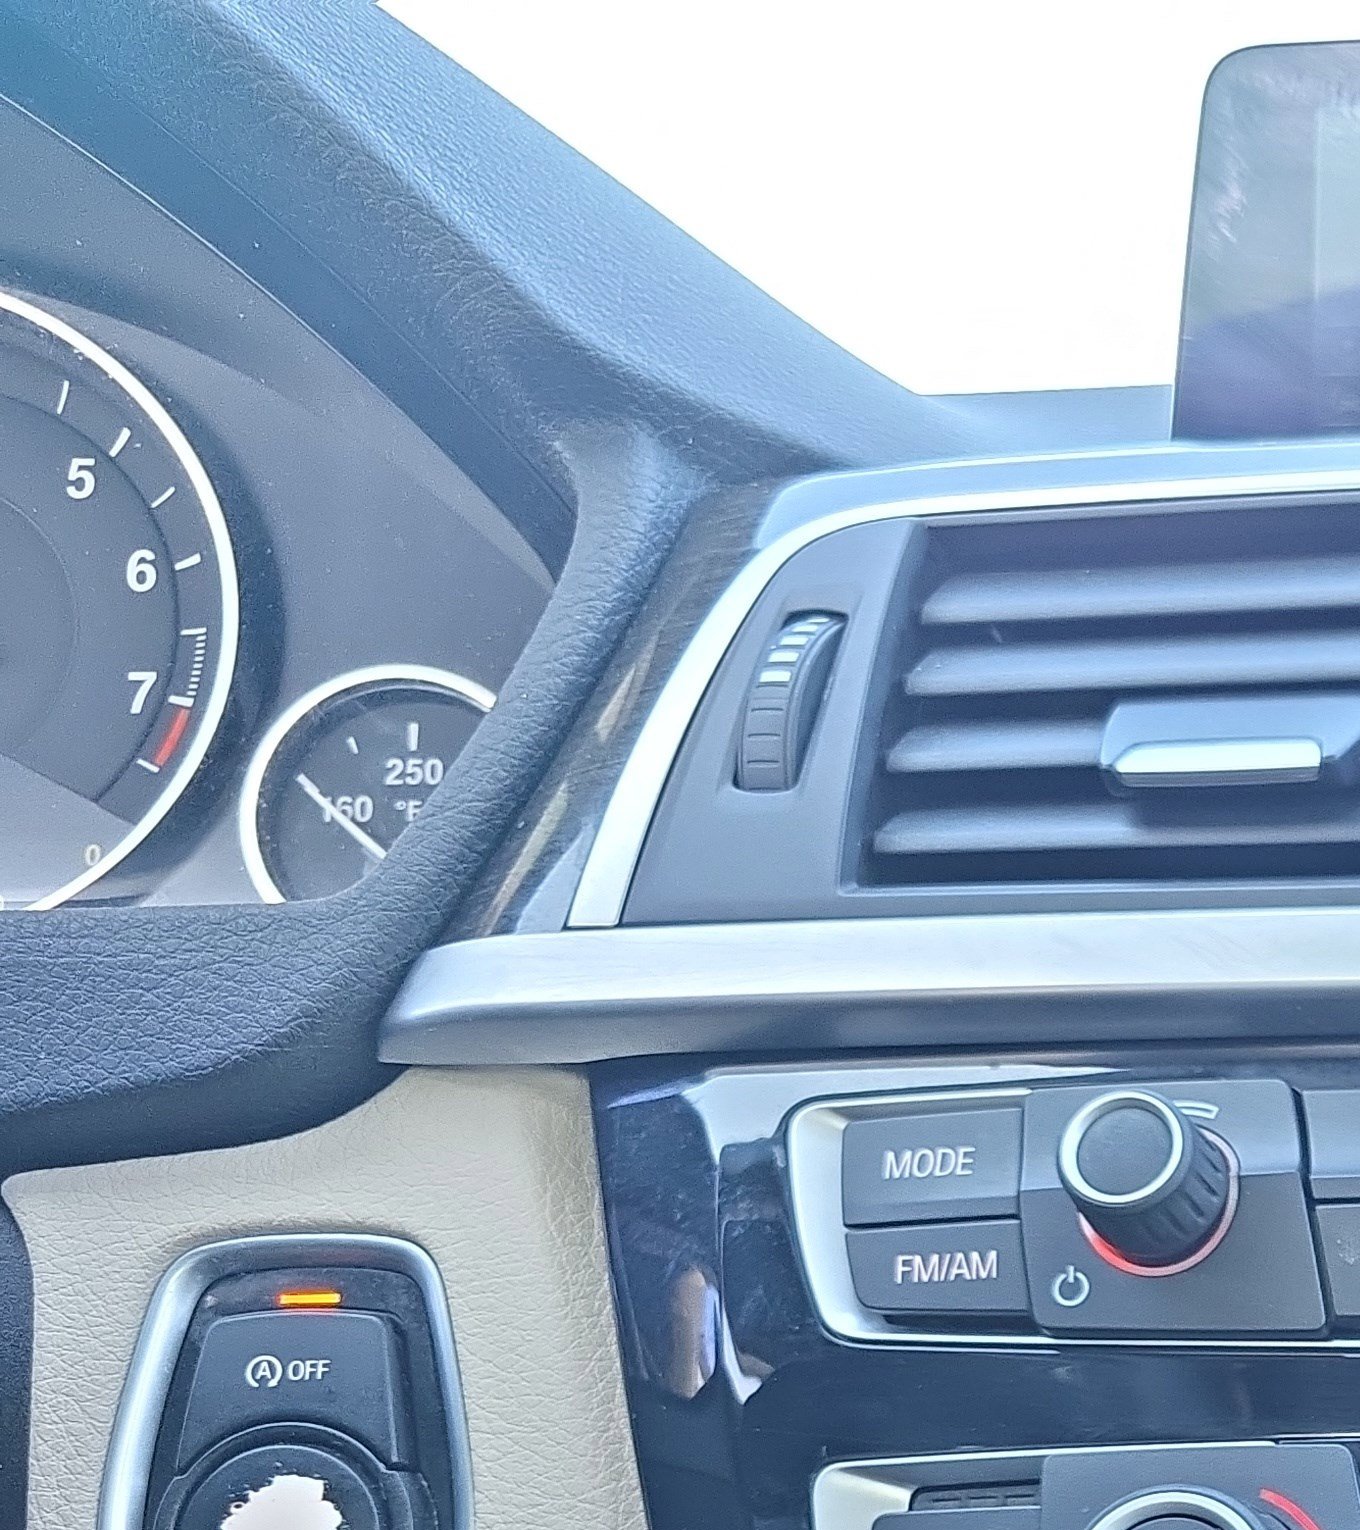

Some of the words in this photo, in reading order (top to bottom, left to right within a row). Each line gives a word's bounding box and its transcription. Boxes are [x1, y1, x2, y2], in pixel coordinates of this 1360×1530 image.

[66, 458, 95, 500] 5
[126, 550, 157, 593] 6
[126, 672, 157, 714] 7
[385, 757, 444, 786] 250
[883, 1146, 976, 1180] MODE
[893, 1250, 998, 1285] FM/AM
[287, 1359, 331, 1381] OFF
